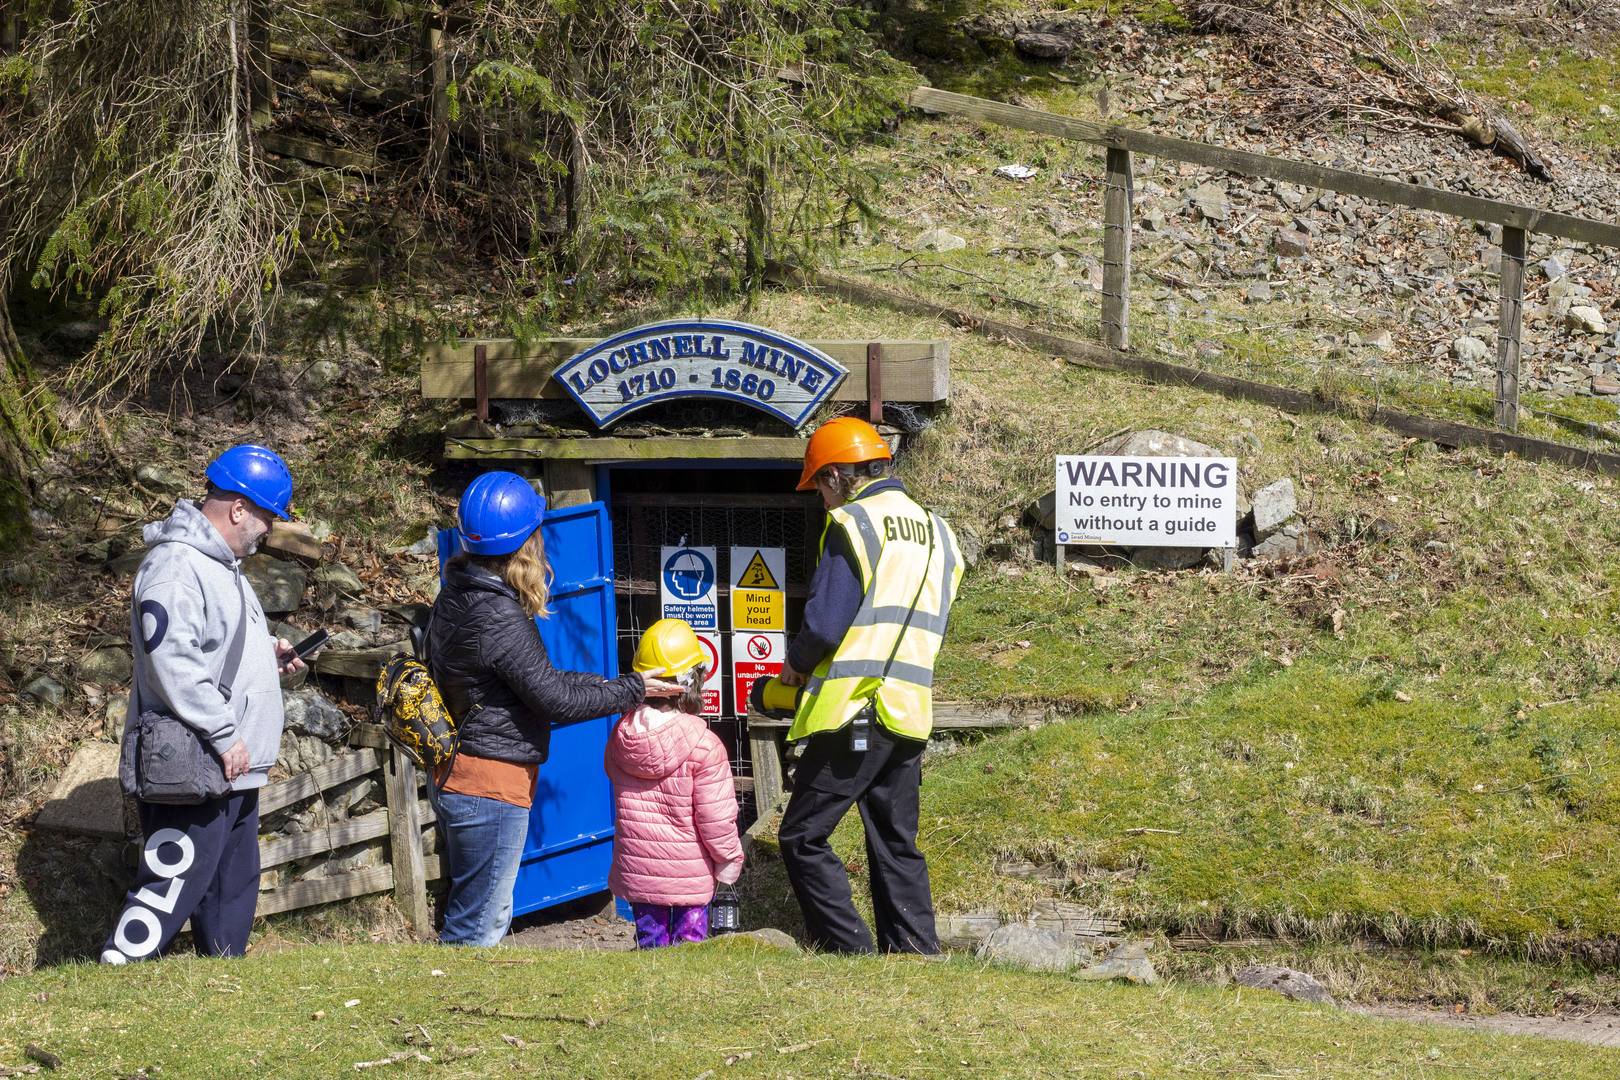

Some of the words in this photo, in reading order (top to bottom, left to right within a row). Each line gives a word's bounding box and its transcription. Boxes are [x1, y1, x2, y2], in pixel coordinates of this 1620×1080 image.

[569, 335, 730, 395] LOCHNELL
[742, 340, 825, 394] MINE
[617, 367, 677, 401] 1710
[711, 366, 776, 401] 1860
[1066, 461, 1228, 488] WARNING
[1069, 491, 1094, 507] No
[1100, 494, 1147, 512] entry
[1153, 494, 1171, 508] to
[1177, 494, 1222, 509] mine
[1074, 515, 1143, 531] without
[1148, 519, 1159, 531] a
[1164, 517, 1217, 535] guide
[746, 594, 771, 603] Mind
[664, 605, 686, 614] Safety
[687, 605, 715, 613] helmets
[747, 605, 771, 615] your
[746, 616, 771, 625] head
[737, 671, 780, 679] unauthoise
[704, 704, 719, 713] only
